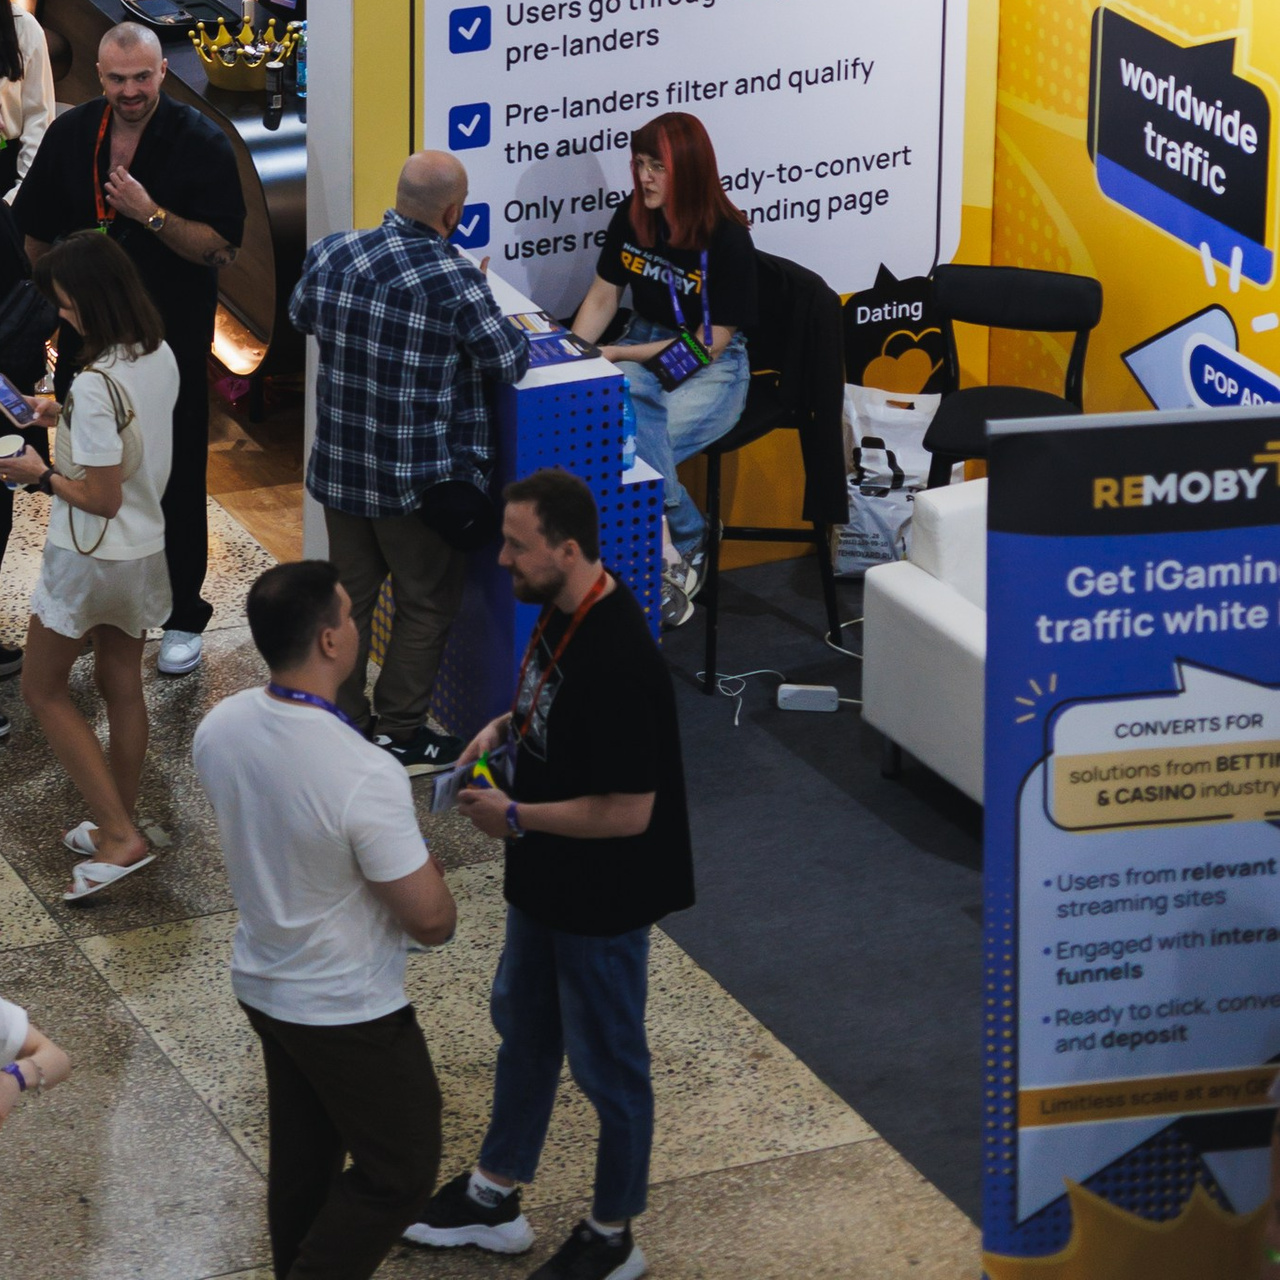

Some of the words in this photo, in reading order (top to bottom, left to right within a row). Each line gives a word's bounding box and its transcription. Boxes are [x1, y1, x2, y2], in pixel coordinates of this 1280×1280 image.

[505, 23, 661, 72] pre-landers
[504, 83, 661, 128] Pre-landers
[665, 76, 729, 107] filter
[734, 67, 782, 97] and
[786, 55, 876, 93] qualify
[1119, 56, 1259, 155] worldwide
[504, 138, 550, 165] the
[1144, 121, 1227, 196] traffic
[504, 197, 564, 229] Only
[720, 143, 913, 195] ady-to-convert
[827, 186, 891, 220] page
[504, 231, 578, 261] users
[856, 296, 924, 326] Dating
[1203, 363, 1240, 399] POP
[1093, 467, 1268, 510] REMOBY
[1066, 564, 1137, 598] Get
[1144, 553, 1280, 593] iGamin
[1036, 608, 1156, 645] traffic
[1163, 601, 1270, 636] white
[1114, 716, 1223, 740] CONVERTS
[1226, 712, 1265, 731] FOR
[1068, 759, 1162, 786] solutions
[1166, 755, 1213, 777] from
[1097, 790, 1110, 807] &
[1114, 783, 1197, 807] CASINO
[1200, 774, 1280, 804] industry
[1056, 871, 1120, 894] Users
[1124, 866, 1178, 888] from
[1181, 856, 1277, 883] relevant
[1056, 892, 1169, 920] streaming
[1172, 888, 1228, 910] sites
[1055, 937, 1154, 964] Engaged
[1156, 929, 1206, 951] with
[1210, 924, 1280, 947] intera
[1055, 962, 1144, 987] funnels
[1055, 1006, 1122, 1029] Ready
[1129, 1003, 1151, 1021] to
[1155, 997, 1211, 1021] click,
[1054, 1032, 1097, 1055] and
[1101, 1023, 1189, 1052] deposit
[1040, 1091, 1126, 1117] Limitless
[1130, 1087, 1179, 1109] scale
[1183, 1085, 1205, 1102] at
[1208, 1082, 1244, 1104] any
